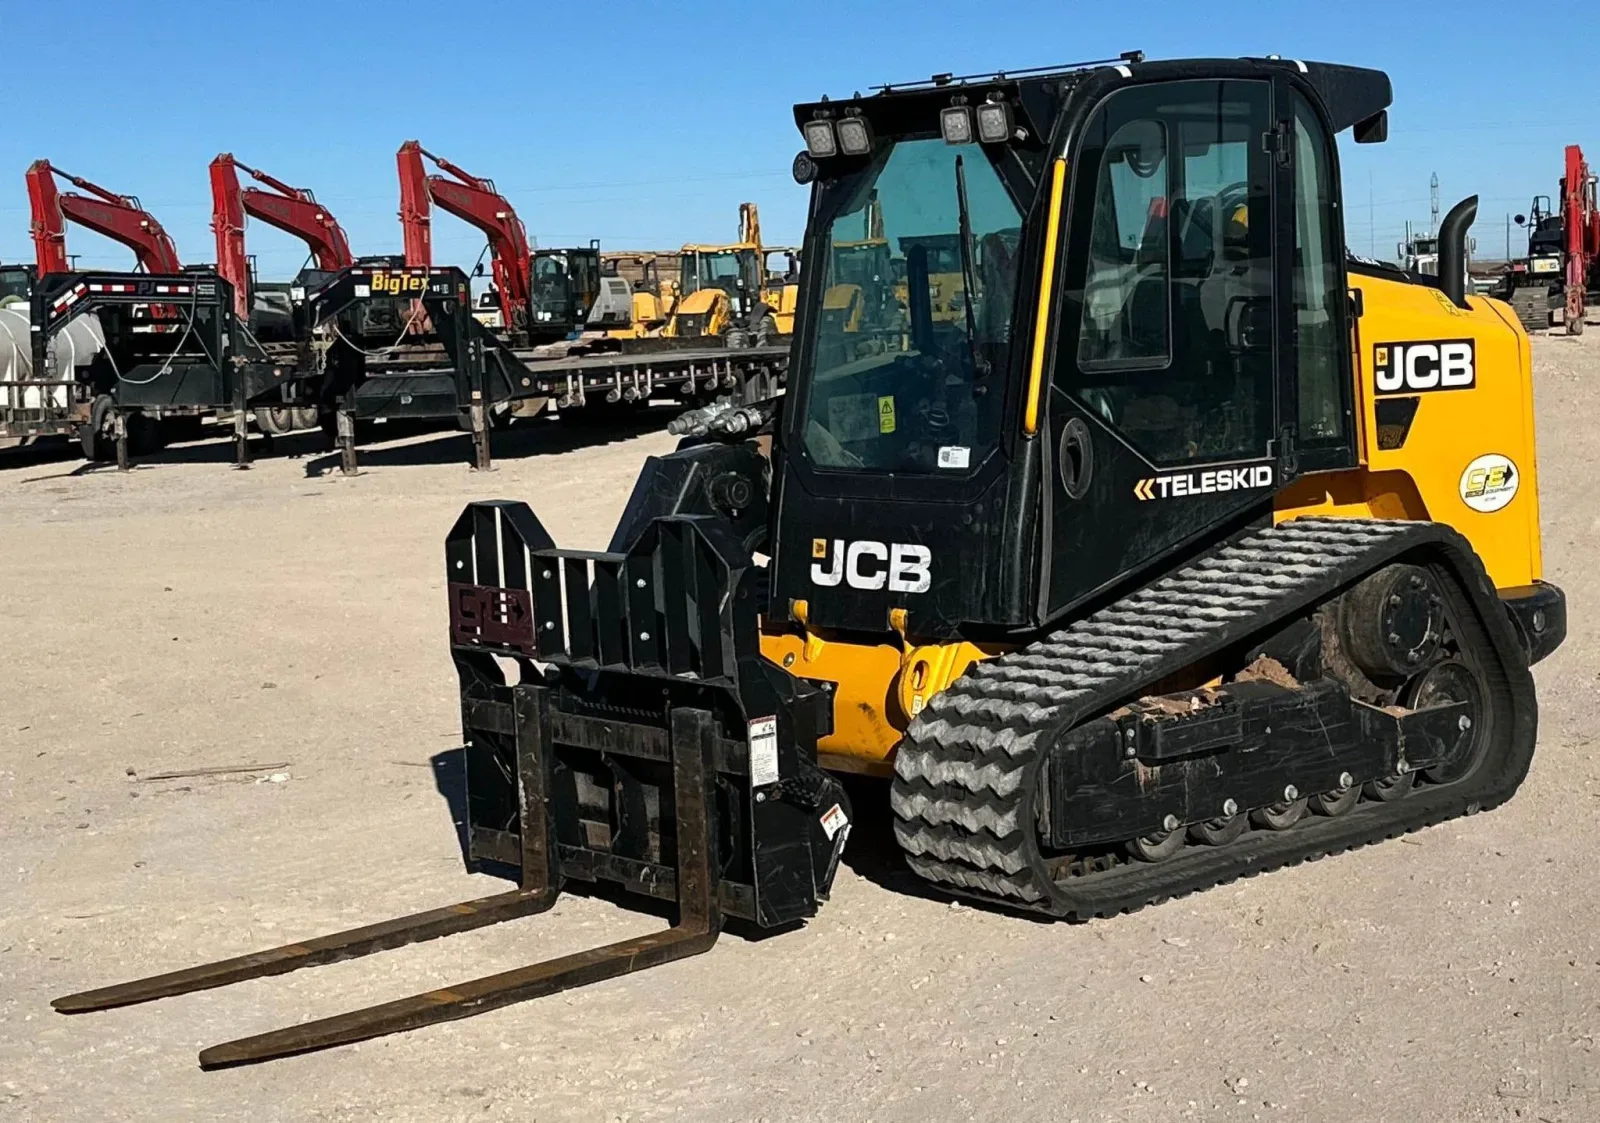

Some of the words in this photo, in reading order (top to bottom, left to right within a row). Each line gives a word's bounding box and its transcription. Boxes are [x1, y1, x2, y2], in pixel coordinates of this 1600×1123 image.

[137, 282, 156, 294] PJ
[371, 273, 429, 295] BigTex
[1376, 343, 1473, 391] JCB
[1156, 466, 1272, 498] TELESKID
[811, 539, 932, 593] JCB
